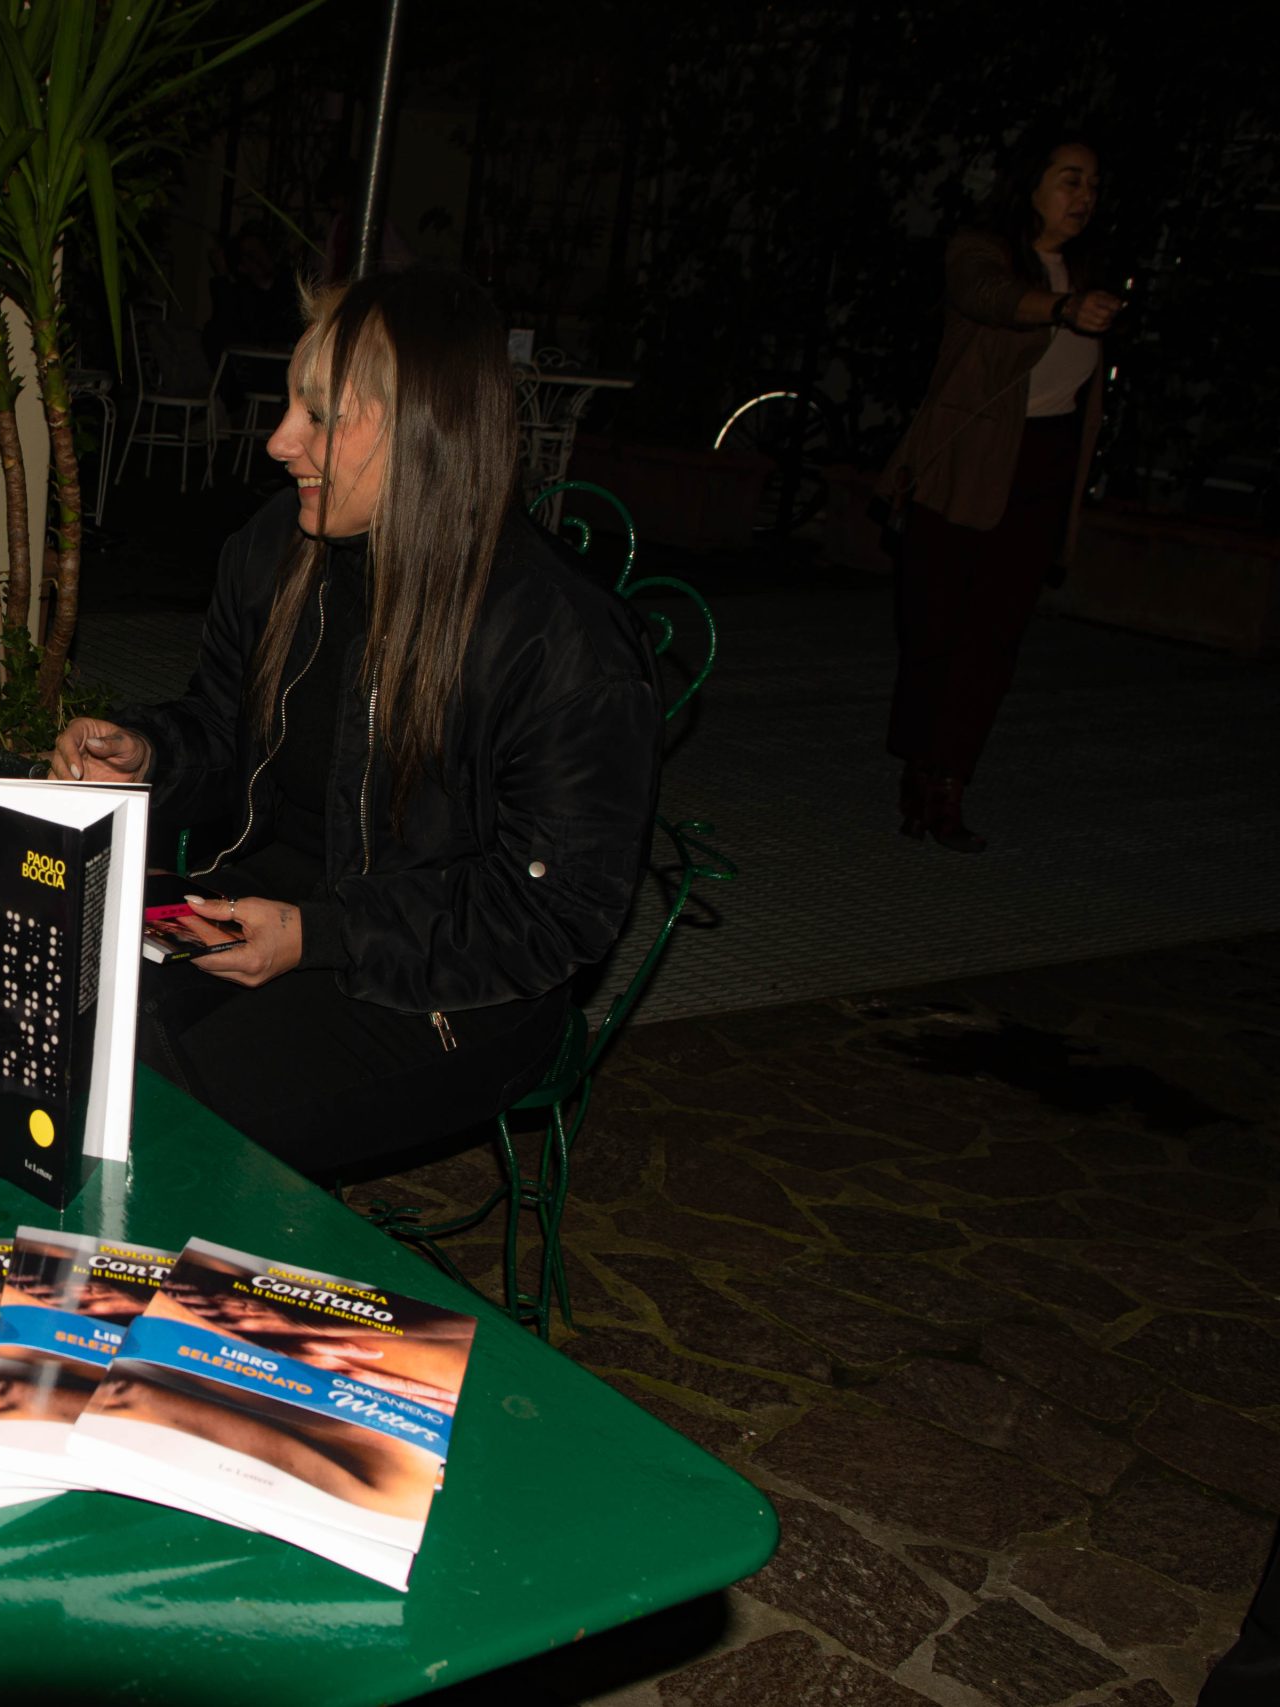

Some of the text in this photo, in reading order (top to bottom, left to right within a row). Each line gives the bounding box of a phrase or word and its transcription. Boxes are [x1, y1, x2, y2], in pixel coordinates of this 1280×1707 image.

[22, 862, 65, 890] BOCCIA
[27, 850, 66, 875] PAOLO
[88, 1255, 171, 1279] ConT
[99, 1245, 153, 1261] PAOLO
[104, 1270, 136, 1283] buio
[148, 1278, 161, 1287] la
[268, 1267, 389, 1305] PAOLO BOCCIA
[232, 1281, 250, 1292] Io,
[252, 1286, 263, 1295] il
[264, 1290, 297, 1305] buio
[309, 1302, 321, 1312] la
[323, 1306, 404, 1336] fisioterapia
[251, 1275, 394, 1322] ConTatto
[177, 1345, 313, 1395] SELEZIONATO
[220, 1346, 279, 1372] LIBRO
[328, 1390, 440, 1442] Writers
